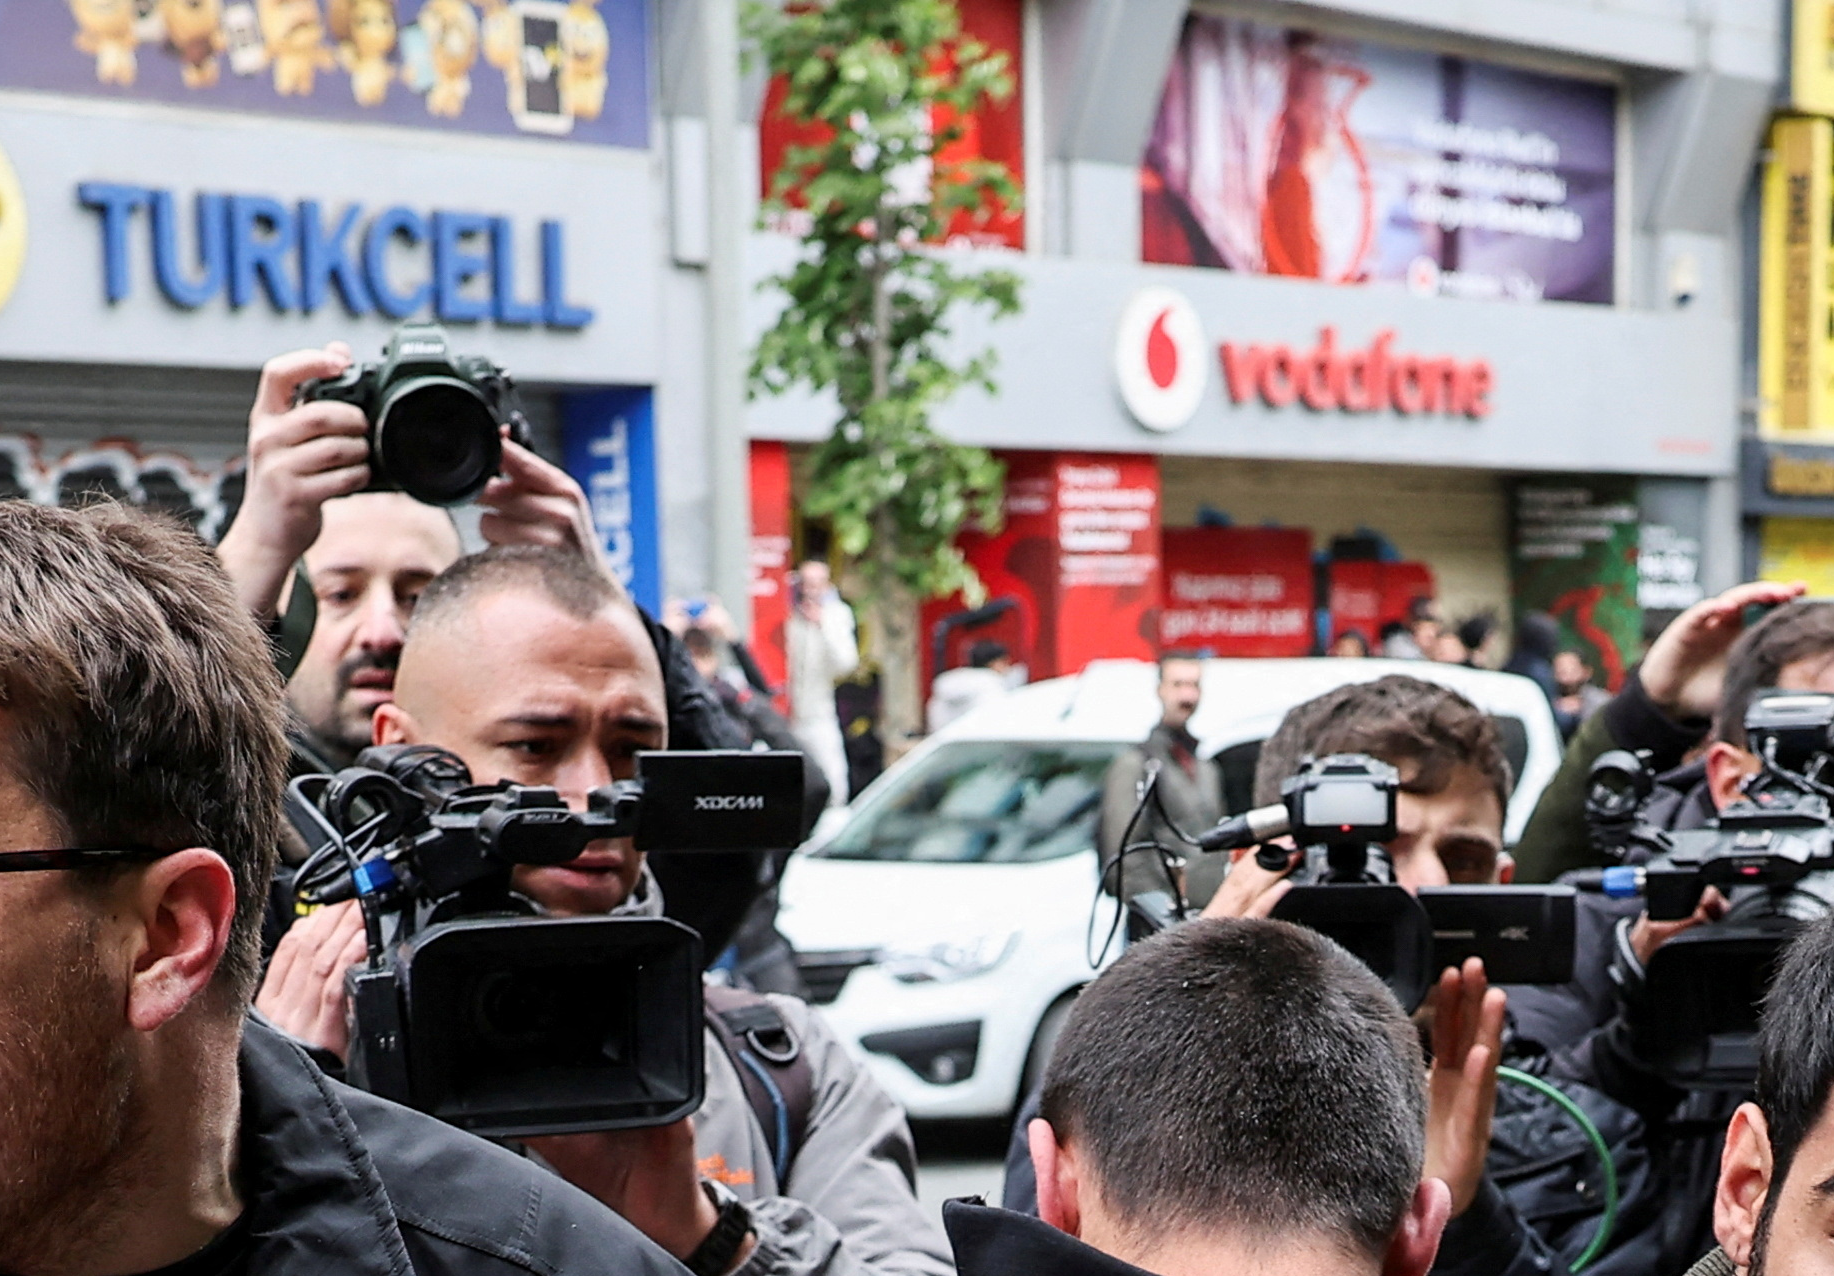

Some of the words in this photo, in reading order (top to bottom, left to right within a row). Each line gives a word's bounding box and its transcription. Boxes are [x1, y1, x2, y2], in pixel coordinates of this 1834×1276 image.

[75, 180, 597, 330] TURKCELL
[1217, 325, 1493, 420] vodafone
[695, 796, 764, 810] XDCAM
